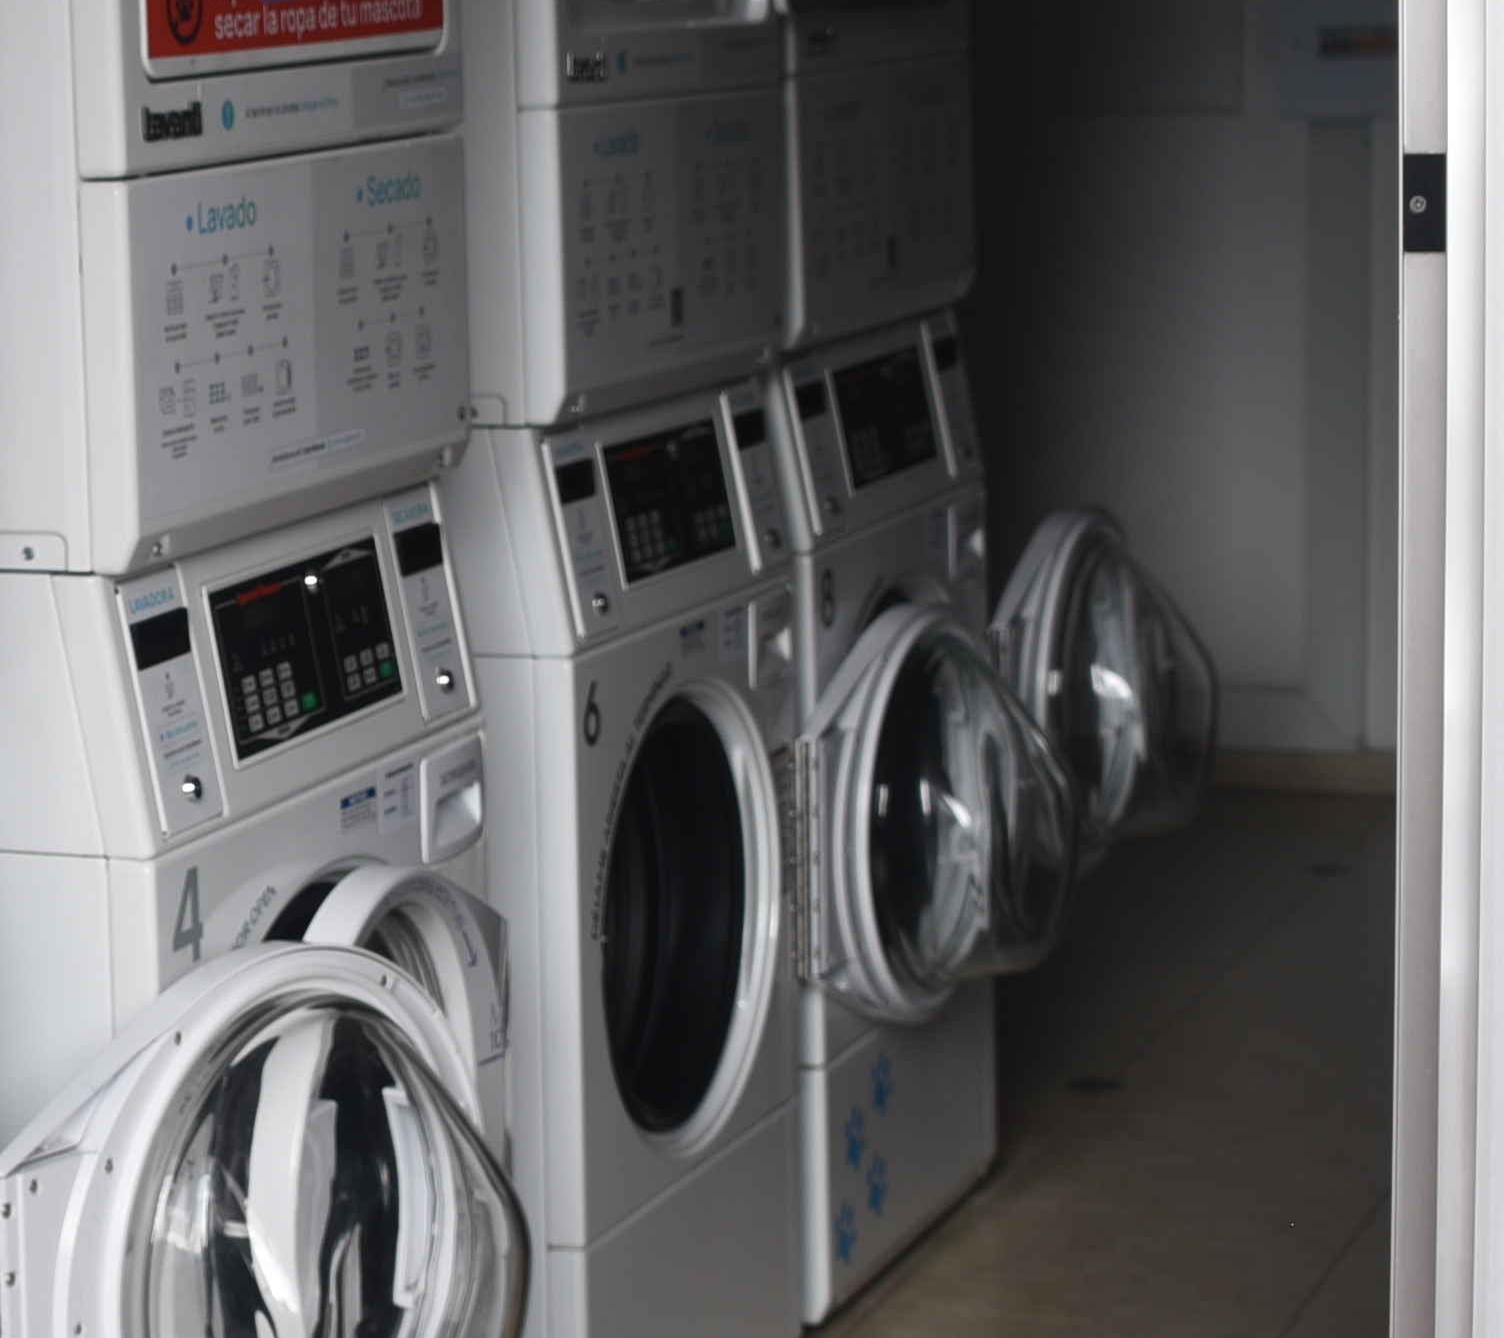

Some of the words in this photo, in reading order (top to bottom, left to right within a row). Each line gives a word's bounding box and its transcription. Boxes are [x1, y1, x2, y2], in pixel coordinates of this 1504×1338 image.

[213, 7, 260, 40] secar
[263, 2, 278, 35] la
[281, 5, 316, 40] ropa
[367, 171, 421, 206] Secado
[196, 196, 257, 235] Lavado
[130, 587, 175, 615] LAVADORA
[583, 680, 601, 747] 6
[172, 865, 203, 960] 4
